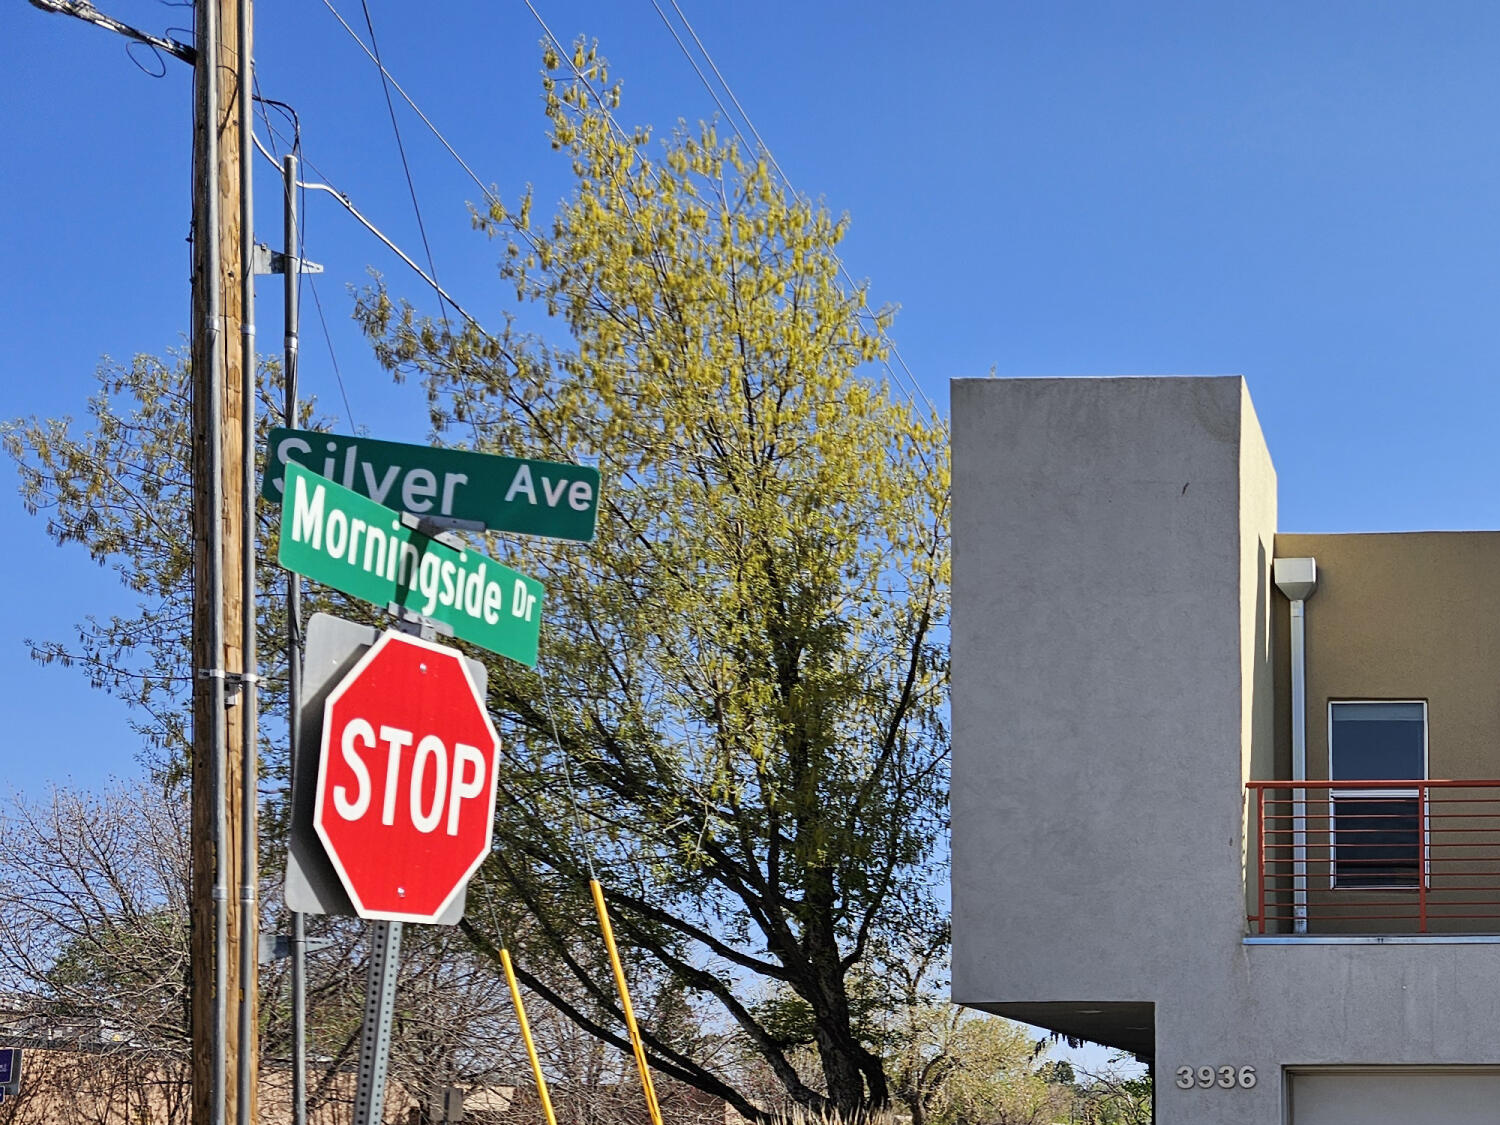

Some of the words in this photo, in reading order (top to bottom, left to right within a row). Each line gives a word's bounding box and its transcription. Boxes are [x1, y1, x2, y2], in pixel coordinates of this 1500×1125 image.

[271, 437, 469, 516] Silver
[504, 464, 593, 512] Ave
[291, 475, 502, 625] Morningside
[511, 578, 537, 622] Dr
[333, 717, 487, 836] STOP
[1176, 1064, 1257, 1089] 3936
